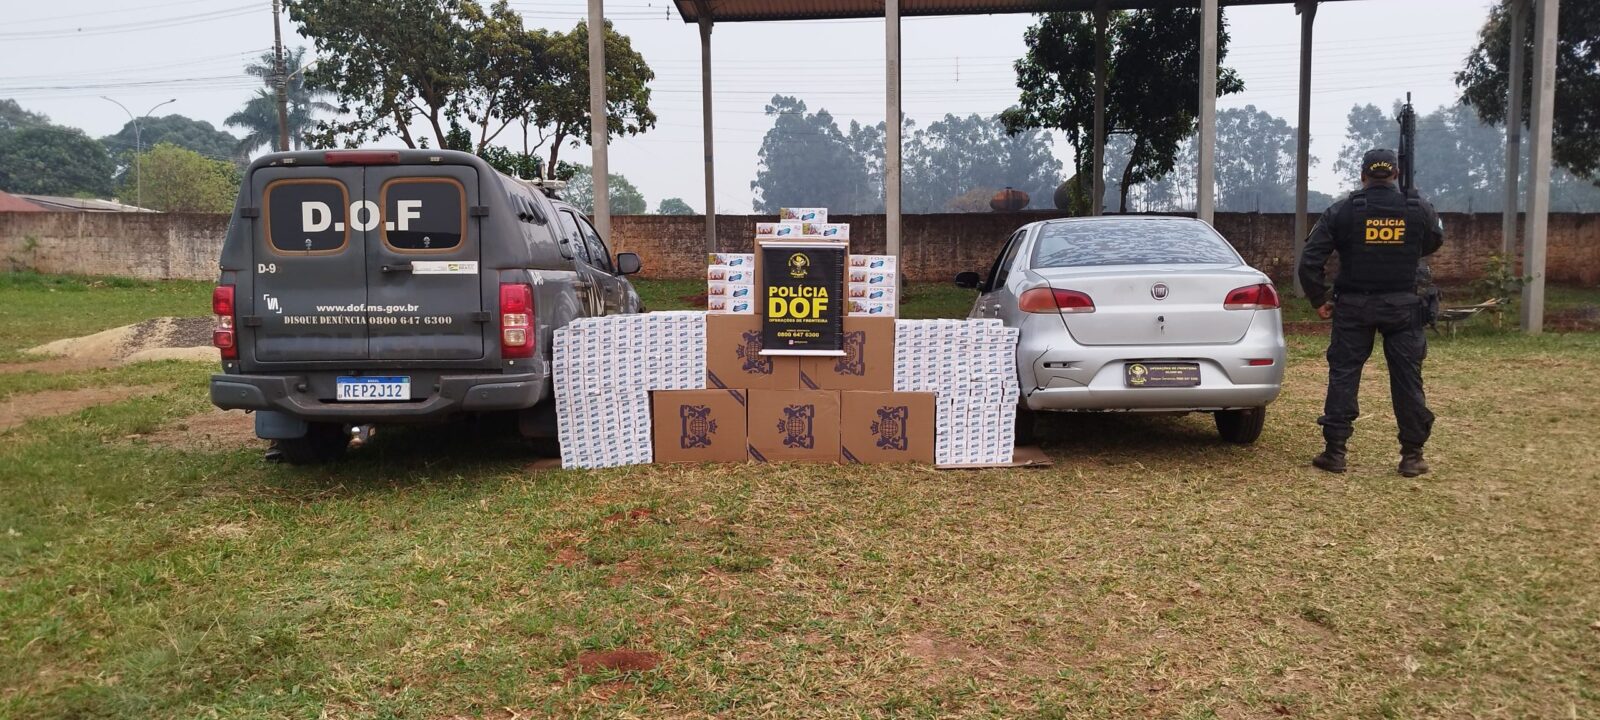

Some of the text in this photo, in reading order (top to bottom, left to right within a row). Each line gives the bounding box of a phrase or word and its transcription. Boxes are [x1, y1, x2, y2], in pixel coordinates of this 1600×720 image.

[1370, 161, 1393, 171] POLÍCIA
[302, 200, 422, 232] D.O.F
[1366, 228, 1405, 240] DOF
[258, 263, 277, 274] D-9
[769, 284, 828, 297] POLÍCIA
[316, 303, 419, 314] www.dof.ms.gov.br
[769, 298, 828, 318] DOF
[284, 313, 453, 325] DISQUE DENÚNCIA 0800 647 6300
[344, 384, 402, 397] REP2J12
